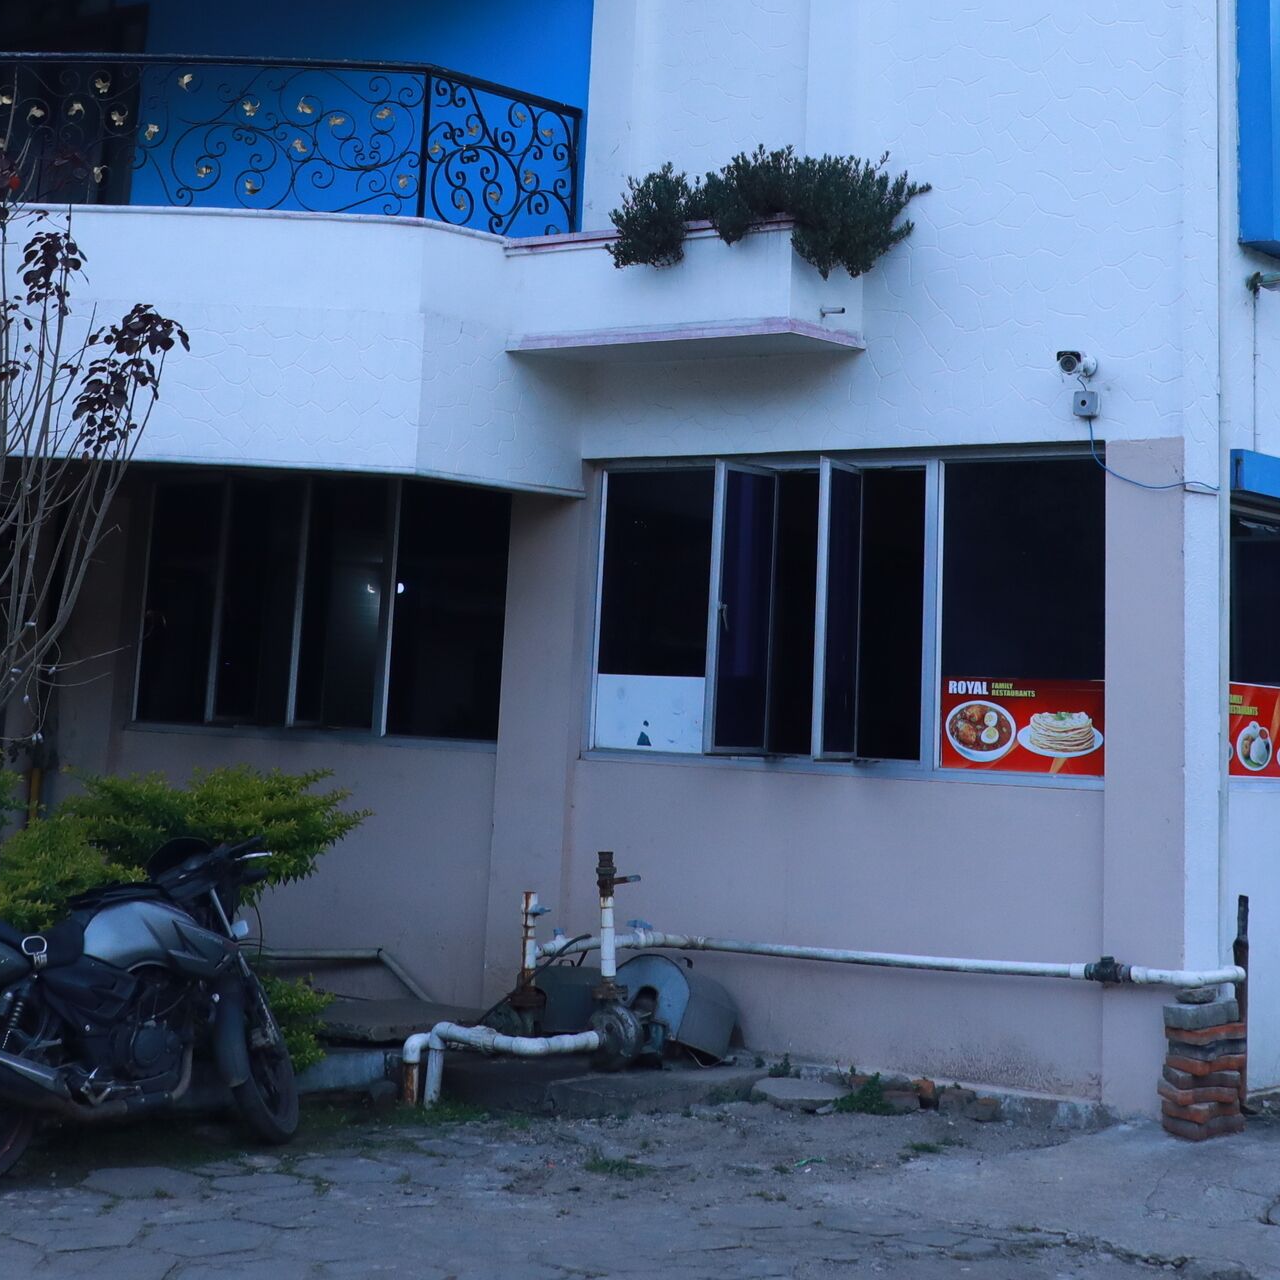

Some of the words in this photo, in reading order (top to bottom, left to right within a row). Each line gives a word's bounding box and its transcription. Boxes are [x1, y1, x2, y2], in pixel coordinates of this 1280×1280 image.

[948, 680, 989, 695] ROYAL
[991, 682, 1014, 690] FAMILY
[991, 689, 1036, 698] RESTAURANTS
